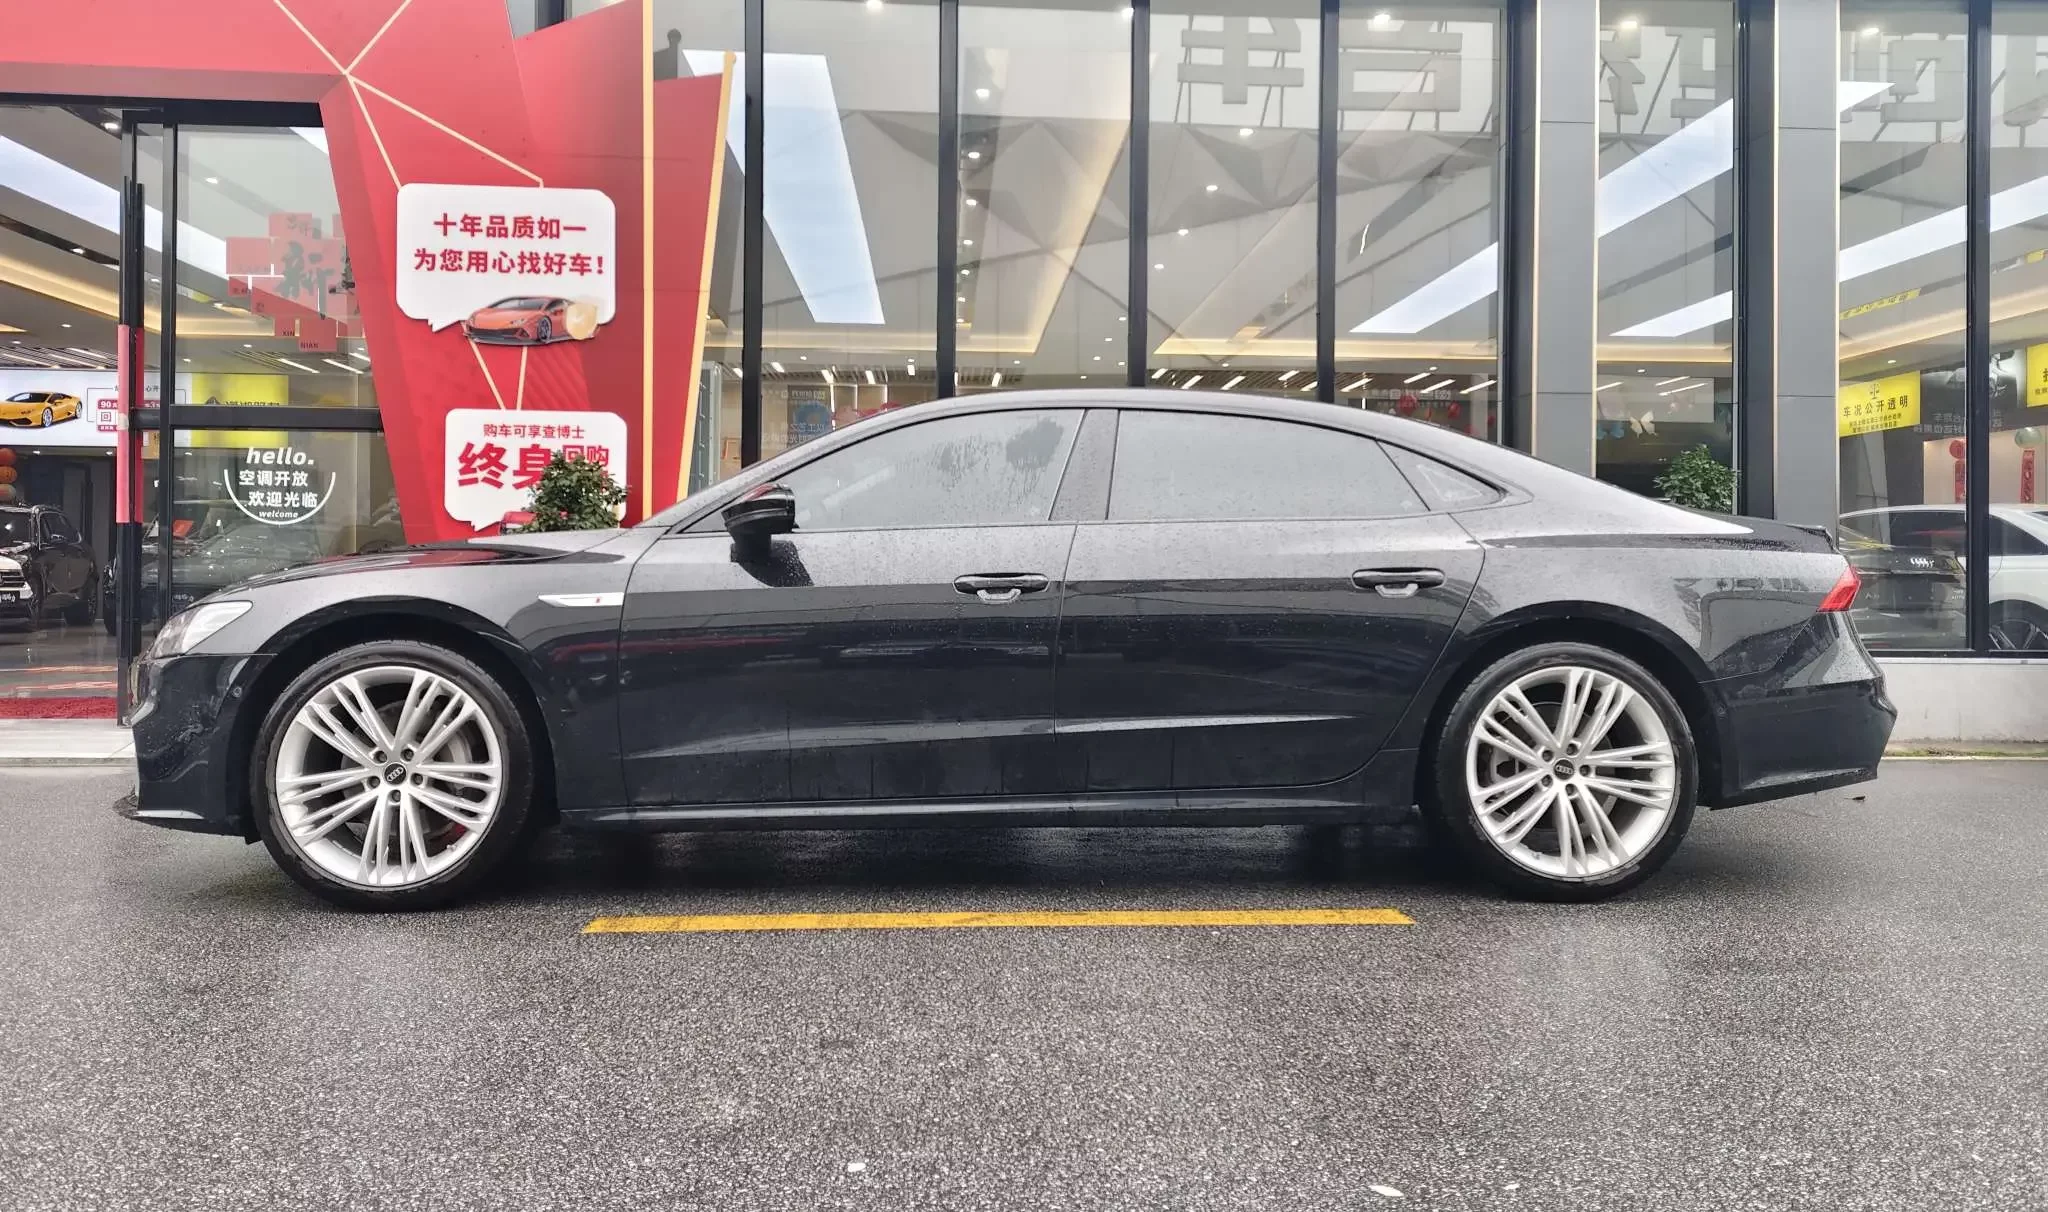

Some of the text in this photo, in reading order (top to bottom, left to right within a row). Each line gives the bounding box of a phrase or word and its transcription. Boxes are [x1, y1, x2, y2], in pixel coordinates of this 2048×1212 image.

[433, 213, 587, 240] 十年品质如一
[414, 248, 604, 276] 为您用心找好车!
[1843, 395, 1909, 418] 车况公开透明
[483, 424, 585, 439] 购车可享查博士
[246, 446, 315, 465] hello.
[239, 470, 308, 487] 空调开放
[248, 490, 318, 508] 欢迎光临
[259, 510, 299, 518] welcome
